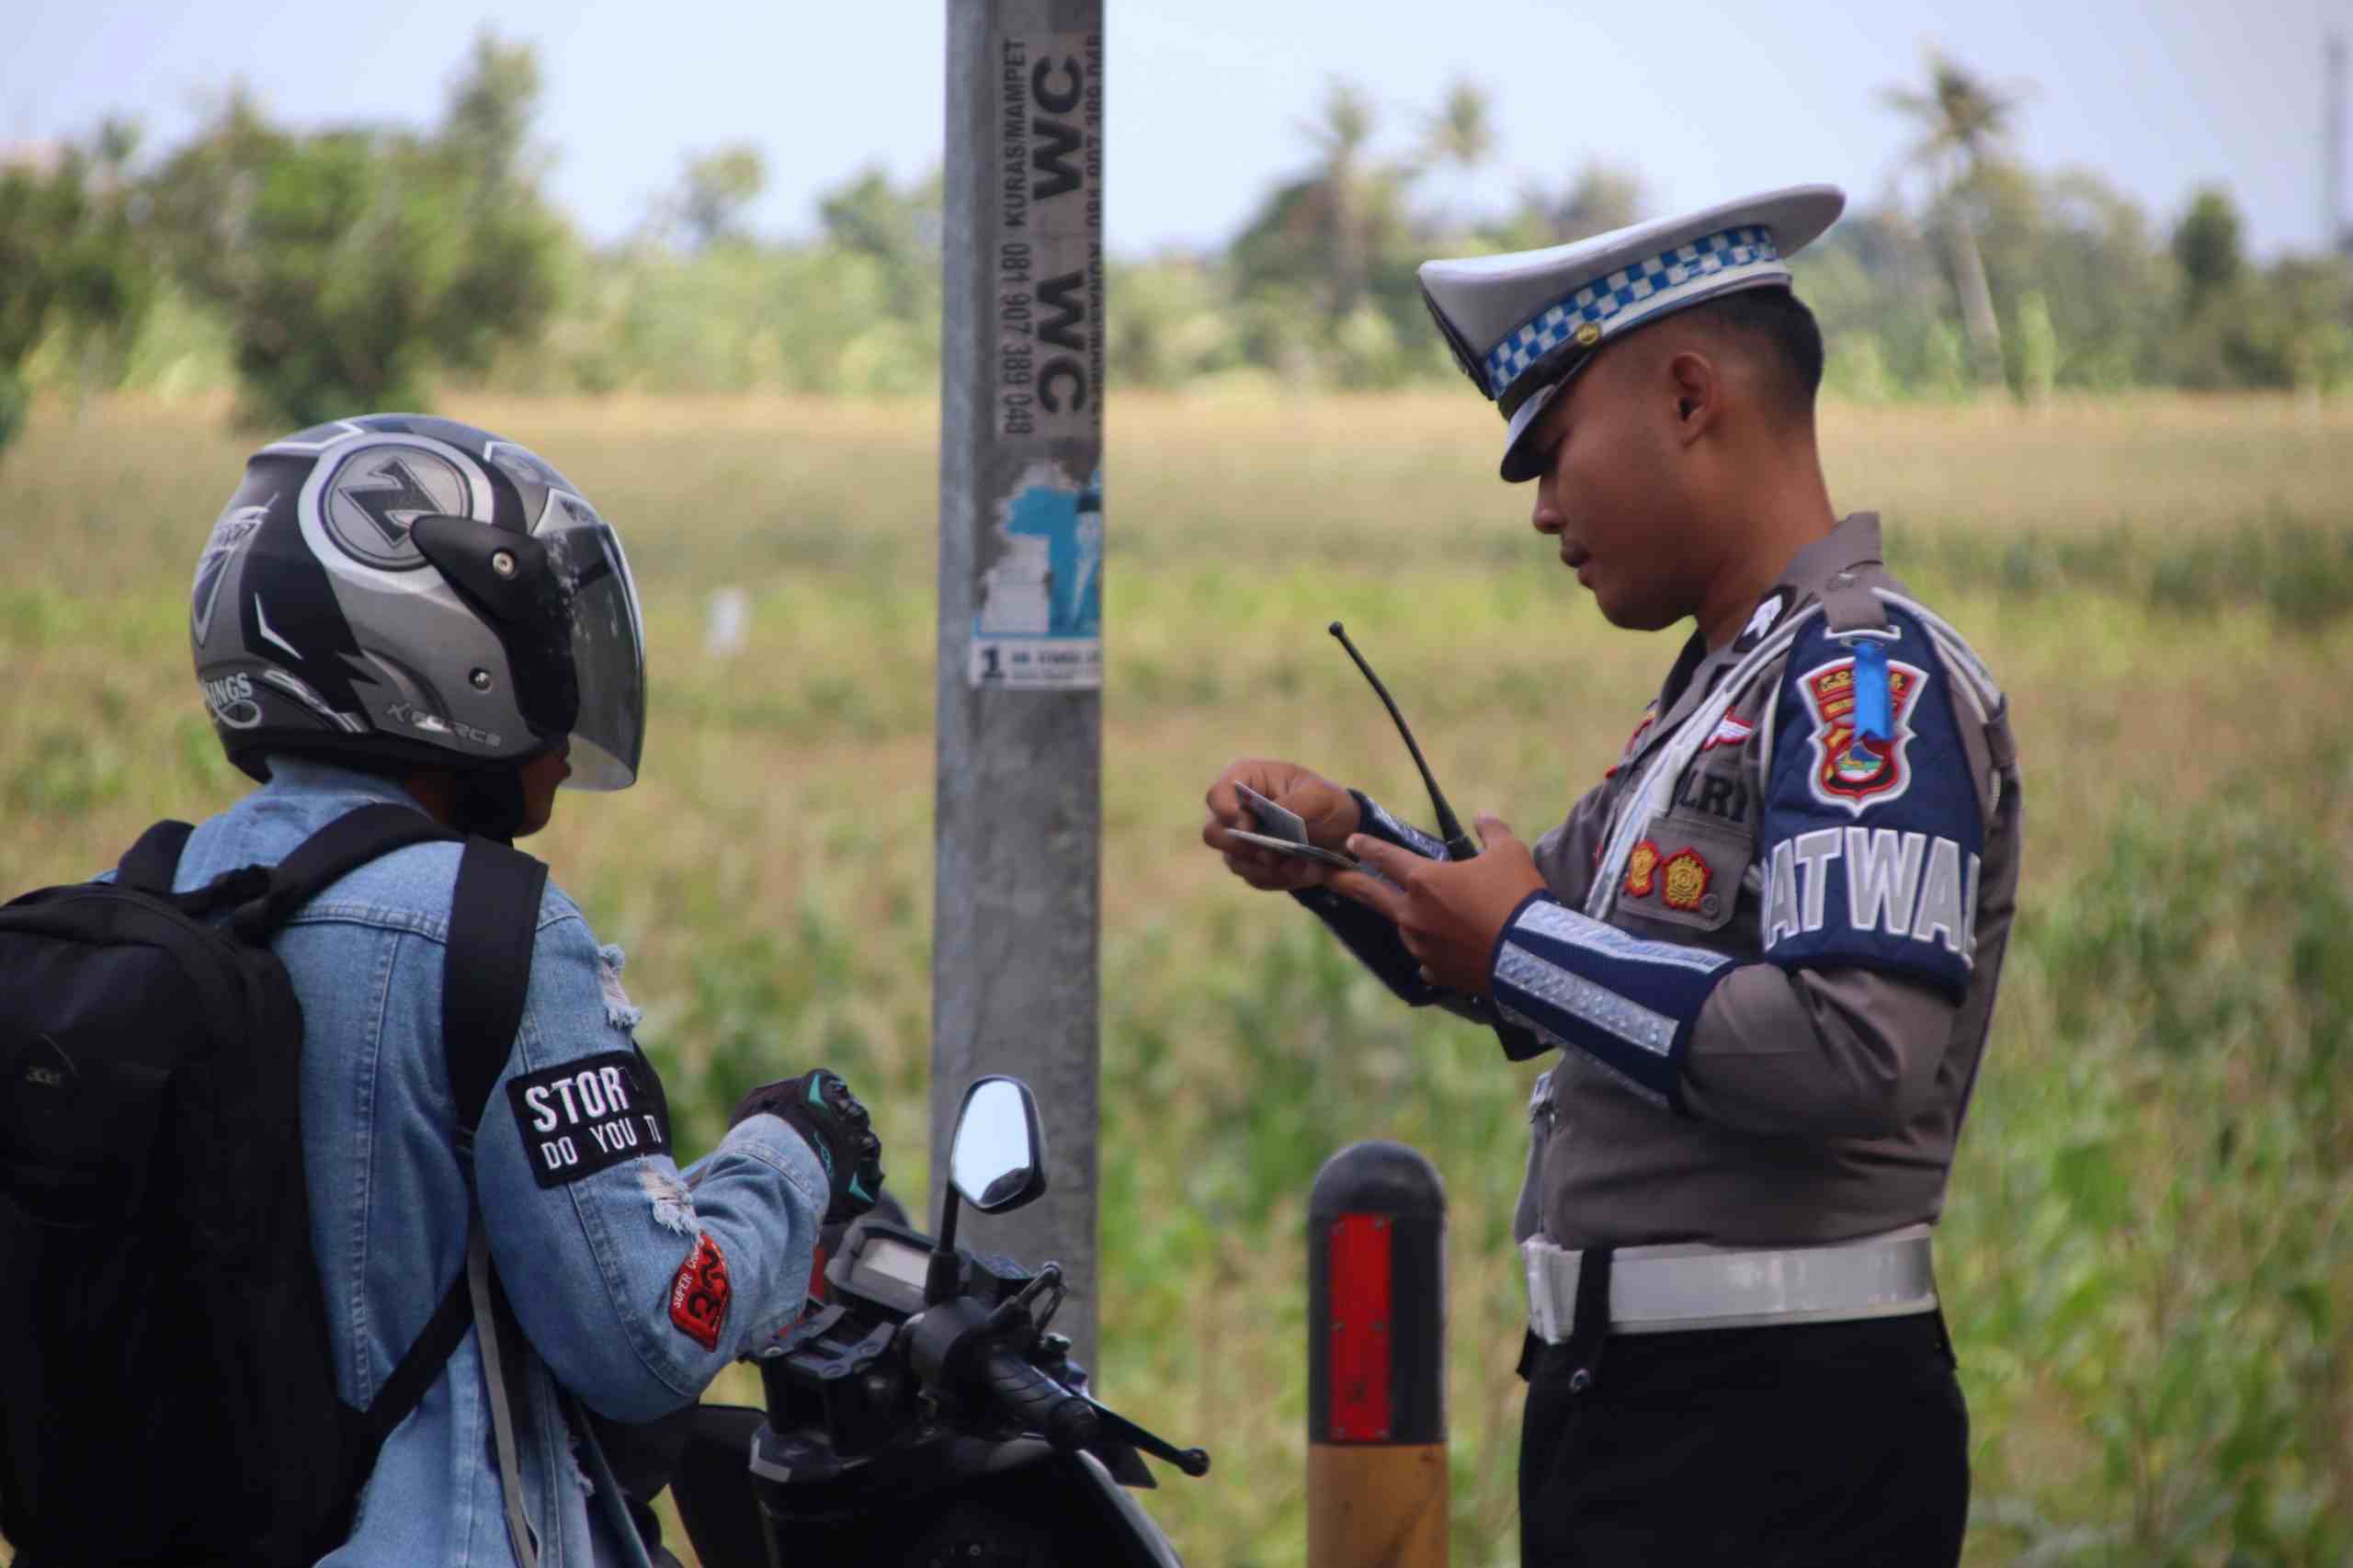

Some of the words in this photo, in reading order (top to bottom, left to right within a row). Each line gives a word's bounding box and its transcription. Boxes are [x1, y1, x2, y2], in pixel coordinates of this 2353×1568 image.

[1004, 40, 1026, 227] KURAS/MAMPET
[1032, 55, 1083, 200] WC
[1000, 243, 1032, 282] 081
[1000, 293, 1033, 335] 907
[1037, 269, 1086, 414] WC
[1001, 343, 1033, 385] 389
[1763, 826, 1980, 968] ATWA
[525, 1066, 634, 1132] STOR
[540, 1136, 578, 1170] DO
[589, 1118, 638, 1153] YOU
